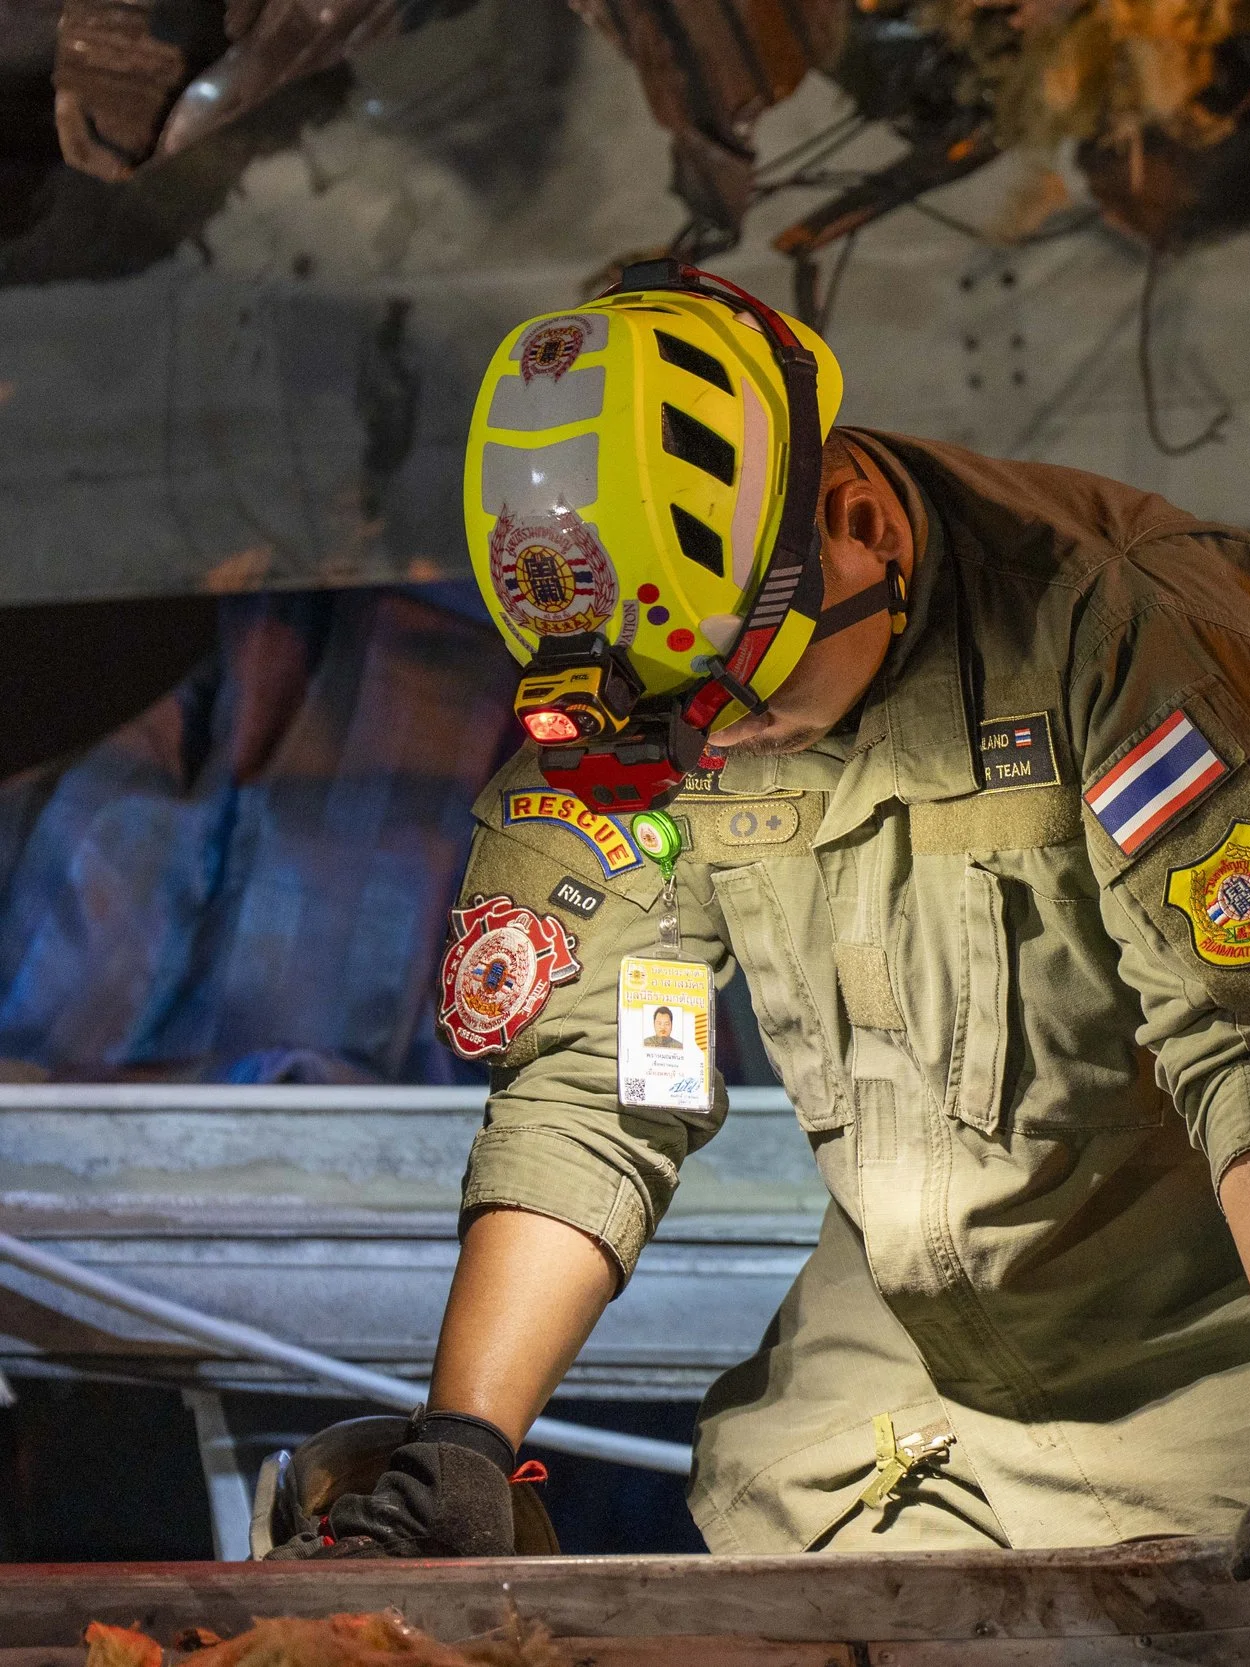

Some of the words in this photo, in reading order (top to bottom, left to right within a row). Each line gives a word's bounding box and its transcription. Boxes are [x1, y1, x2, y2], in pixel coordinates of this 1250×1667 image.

[618, 602, 636, 648] DATION
[981, 733, 1009, 751] LAND
[984, 766, 992, 781] R
[995, 760, 1031, 779] TEAM
[513, 795, 630, 866] RESCUE
[457, 1027, 470, 1039] FIRE
